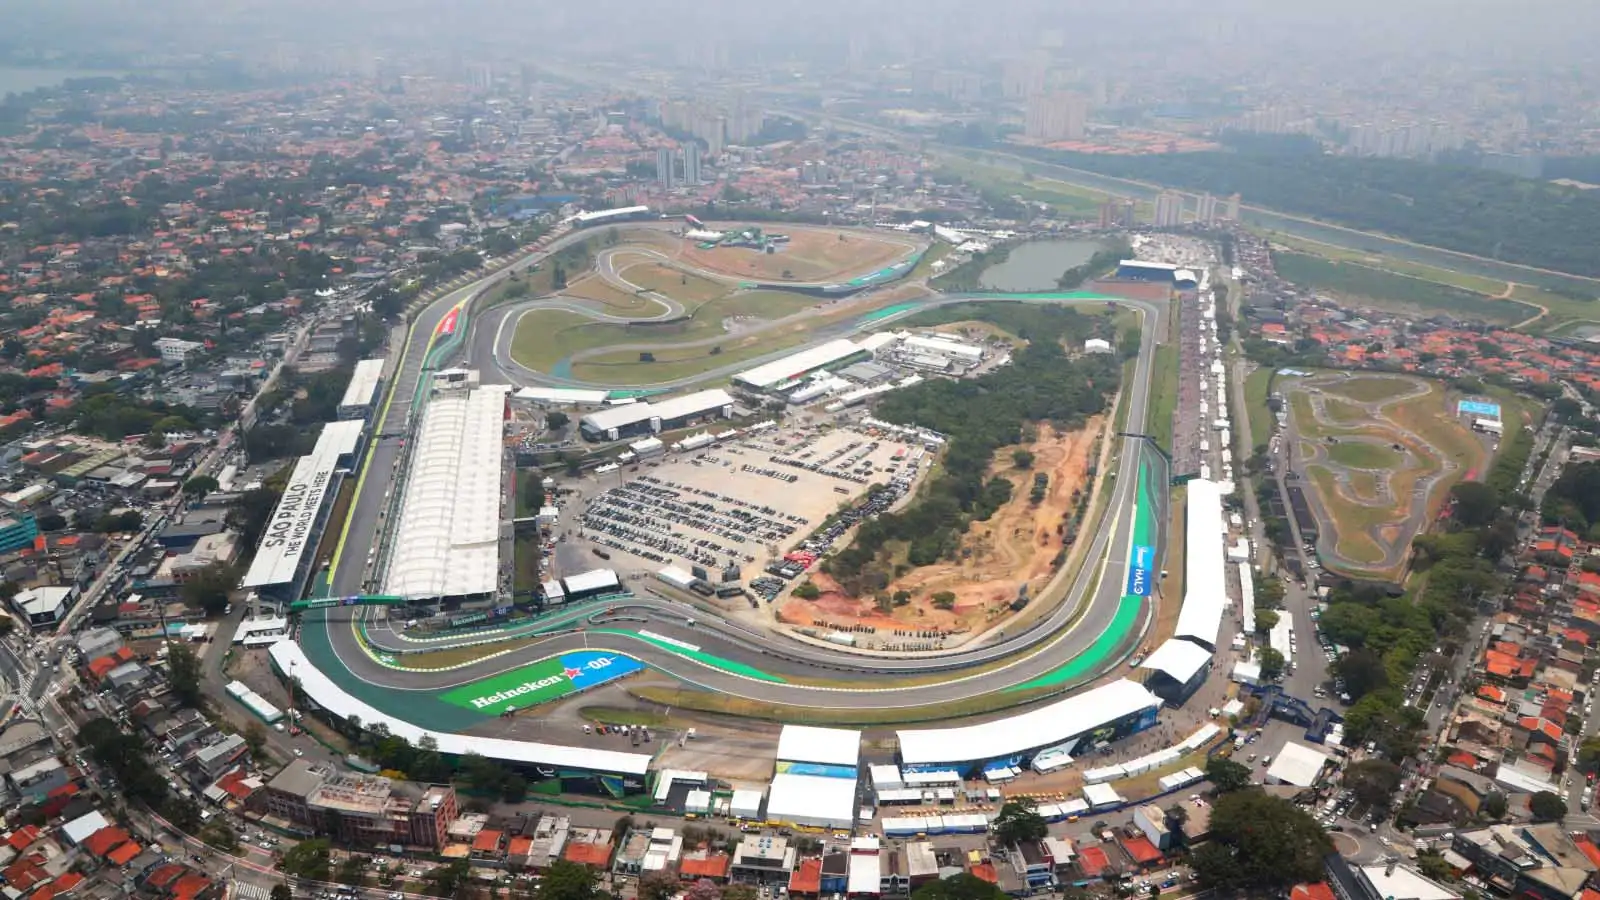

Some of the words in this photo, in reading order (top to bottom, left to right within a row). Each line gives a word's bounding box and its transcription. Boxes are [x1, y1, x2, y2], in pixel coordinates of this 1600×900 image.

[312, 471, 329, 488] HERE
[277, 484, 307, 519] PAULO
[303, 488, 322, 511] MEETS
[291, 511, 312, 540] WORLD
[284, 541, 301, 557] THE
[469, 675, 563, 709] Heineken
